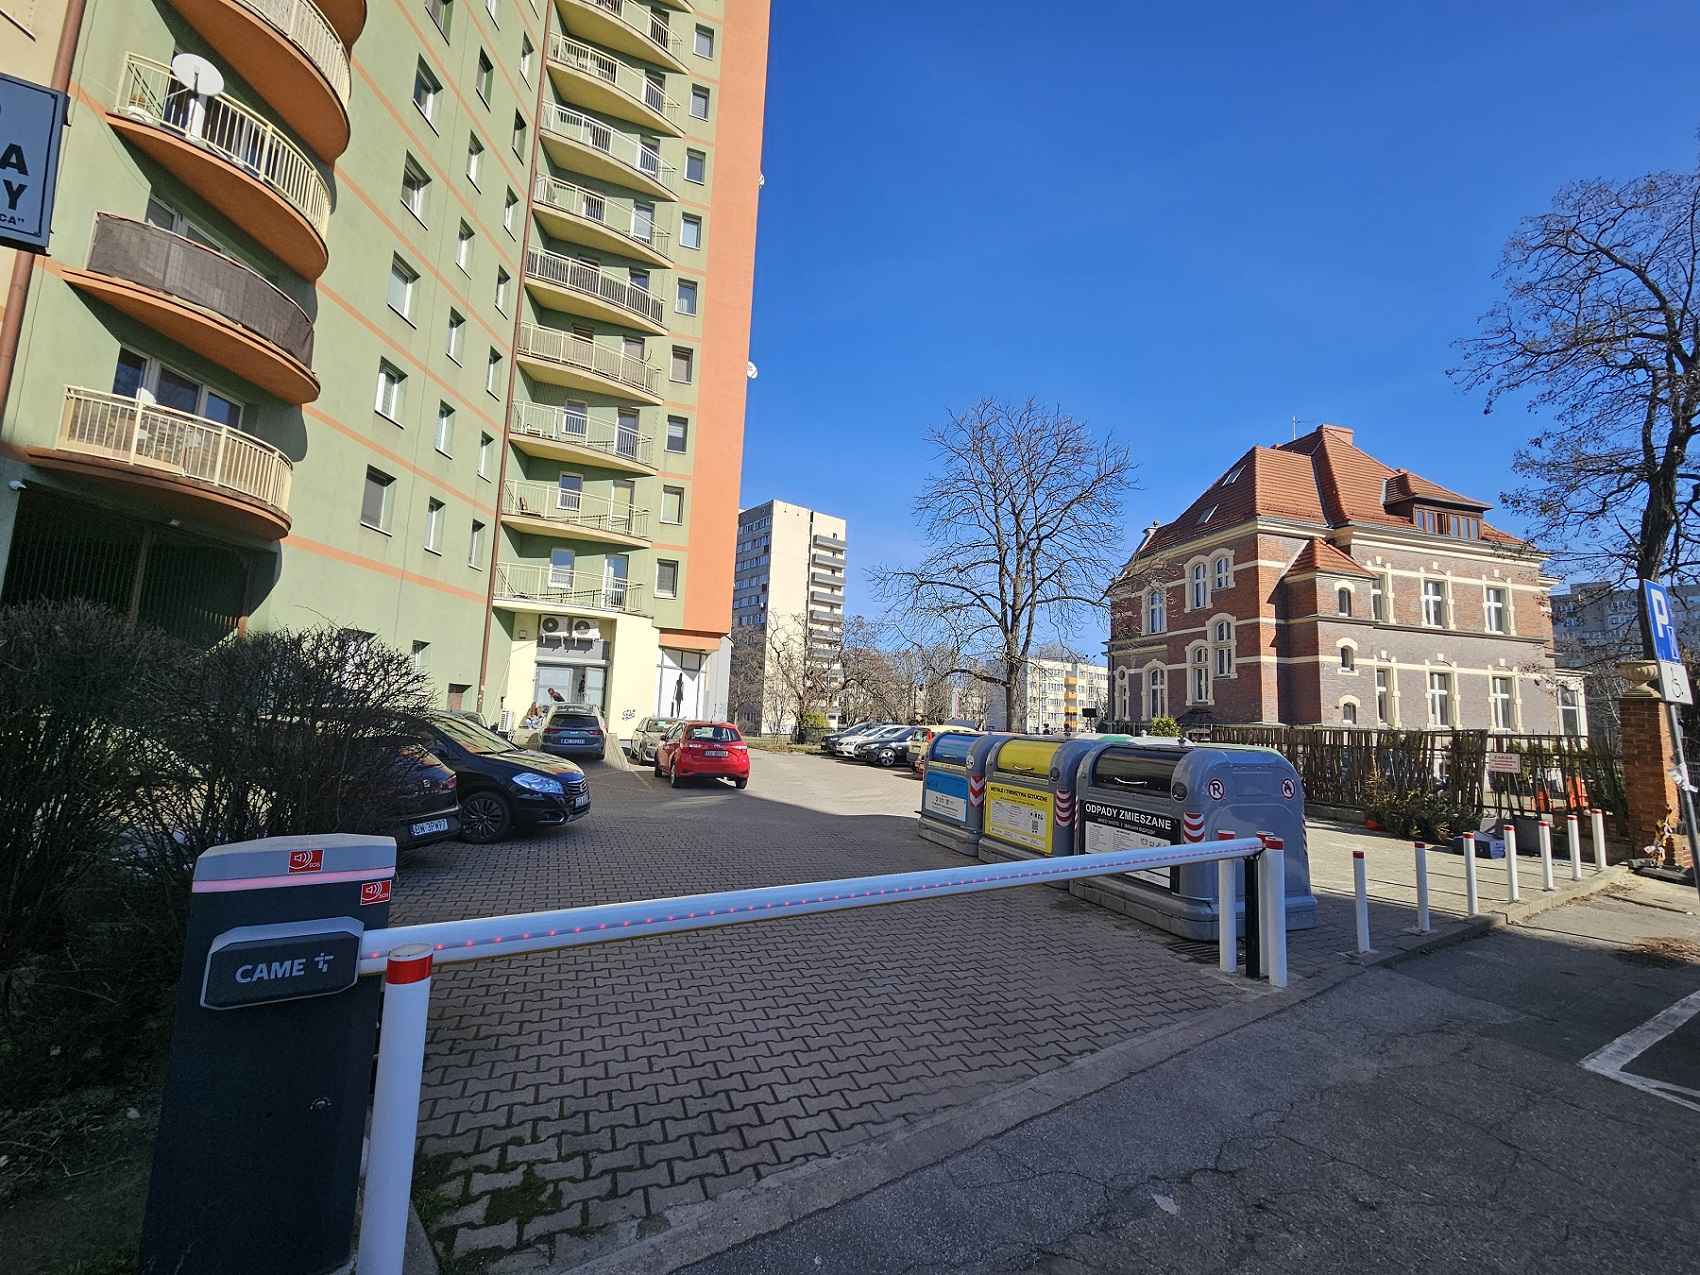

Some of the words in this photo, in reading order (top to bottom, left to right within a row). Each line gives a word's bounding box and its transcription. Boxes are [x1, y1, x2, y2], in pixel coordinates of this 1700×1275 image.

[1651, 588, 1669, 639] P
[1085, 803, 1118, 818] ODPADY
[1119, 809, 1172, 830] ZMIESZANE
[235, 958, 306, 983] CAME
